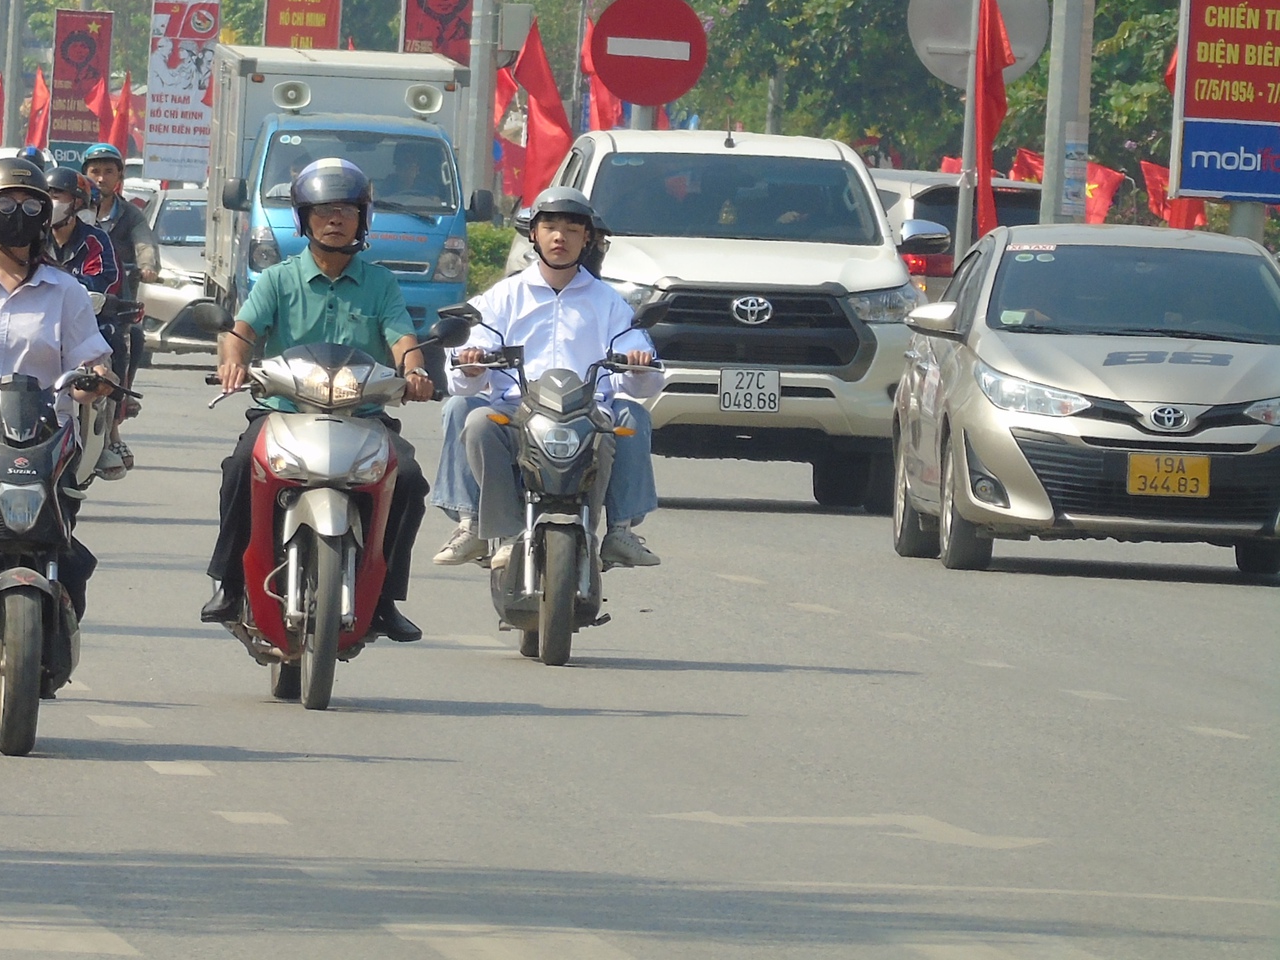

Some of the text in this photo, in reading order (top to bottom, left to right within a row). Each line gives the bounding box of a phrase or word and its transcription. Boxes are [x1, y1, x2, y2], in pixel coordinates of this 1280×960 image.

[1205, 1, 1260, 30] CHIẾN
[1197, 38, 1239, 68] ĐIỆN
[171, 94, 191, 104] NAM
[1195, 78, 1255, 103] (7/5/1954
[735, 371, 766, 390] 27C
[722, 391, 777, 410] 048.68
[1155, 456, 1186, 474] 19A
[1137, 475, 1200, 494] 344.83
